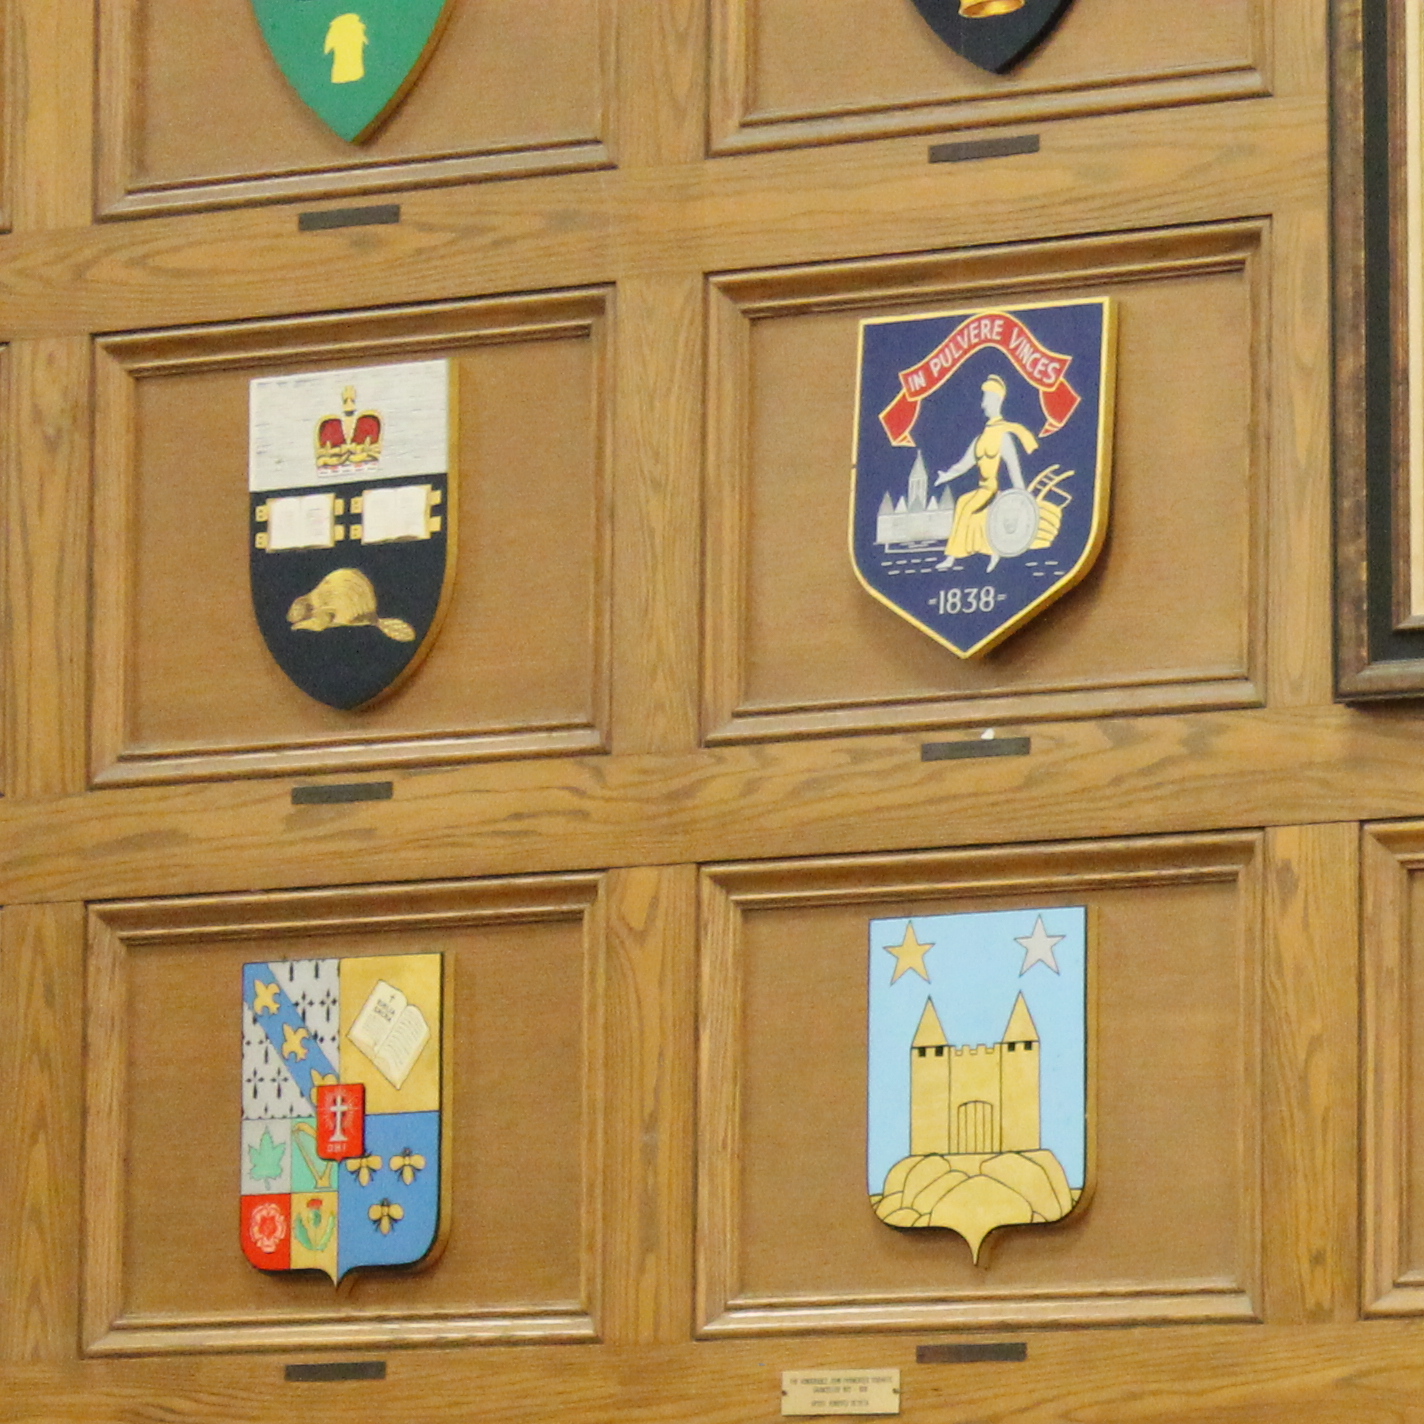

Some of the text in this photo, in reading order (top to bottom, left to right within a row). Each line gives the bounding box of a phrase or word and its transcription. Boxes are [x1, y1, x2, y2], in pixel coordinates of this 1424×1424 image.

[907, 319, 1061, 392] IN PULVERE VINCES
